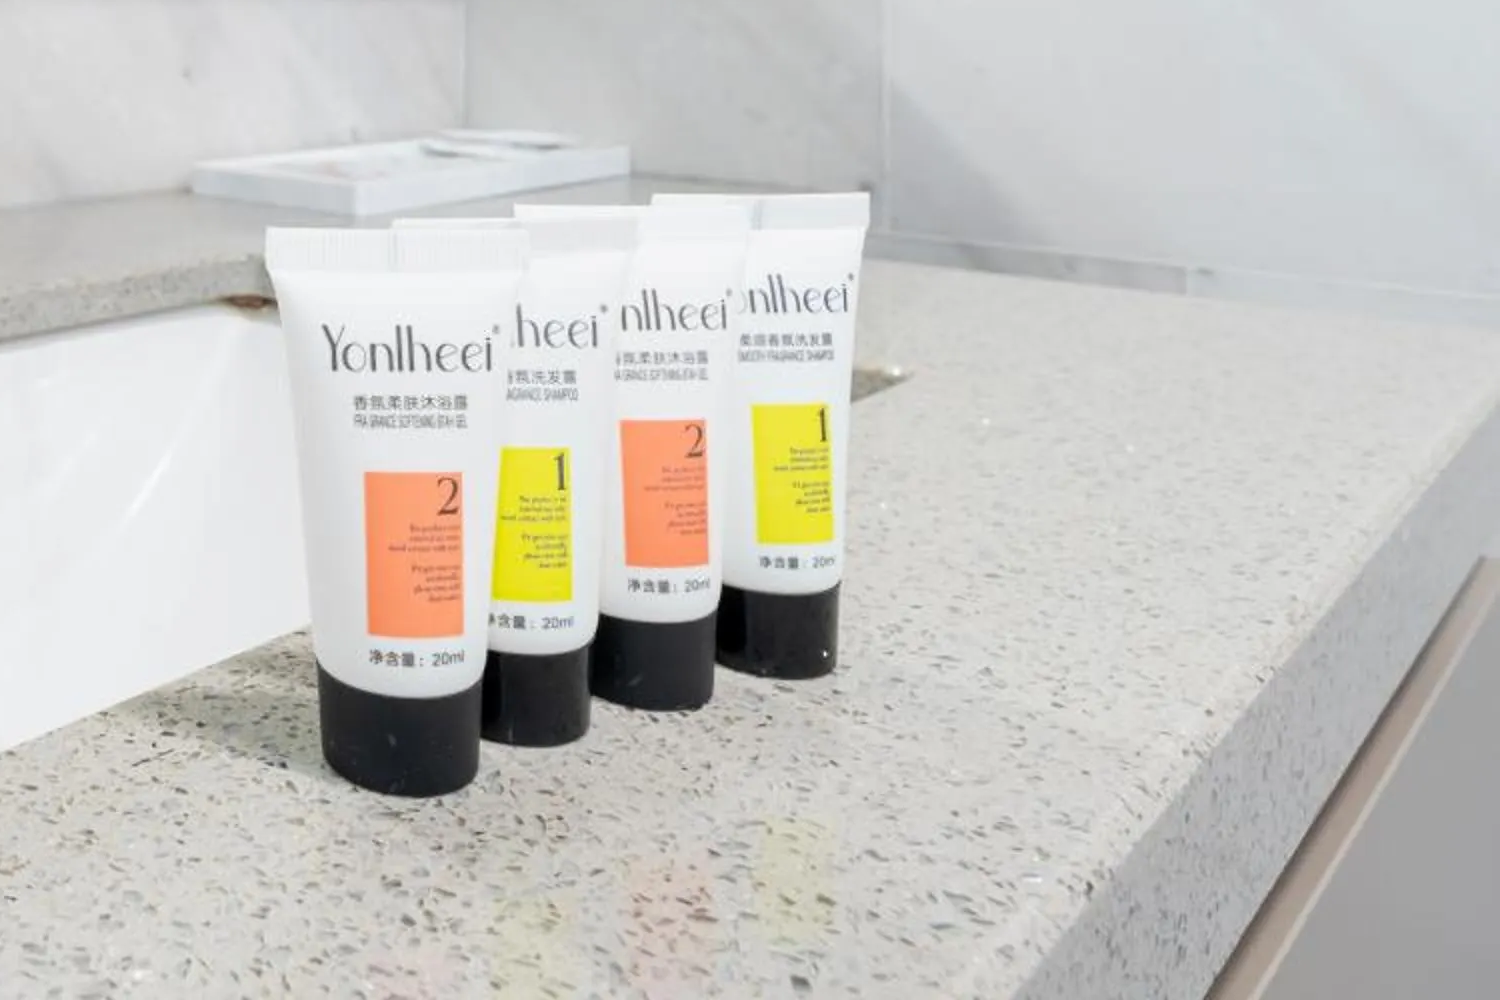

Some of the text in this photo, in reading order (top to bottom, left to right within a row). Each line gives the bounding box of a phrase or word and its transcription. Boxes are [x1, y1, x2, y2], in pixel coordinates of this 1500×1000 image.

[515, 303, 598, 349] heei
[621, 287, 727, 331] nlheei
[321, 324, 492, 373] Yonlheei
[685, 423, 704, 459] 2
[818, 407, 828, 442] 1
[553, 452, 566, 491] 1
[437, 477, 459, 516] 2
[431, 647, 465, 668] 20ml
